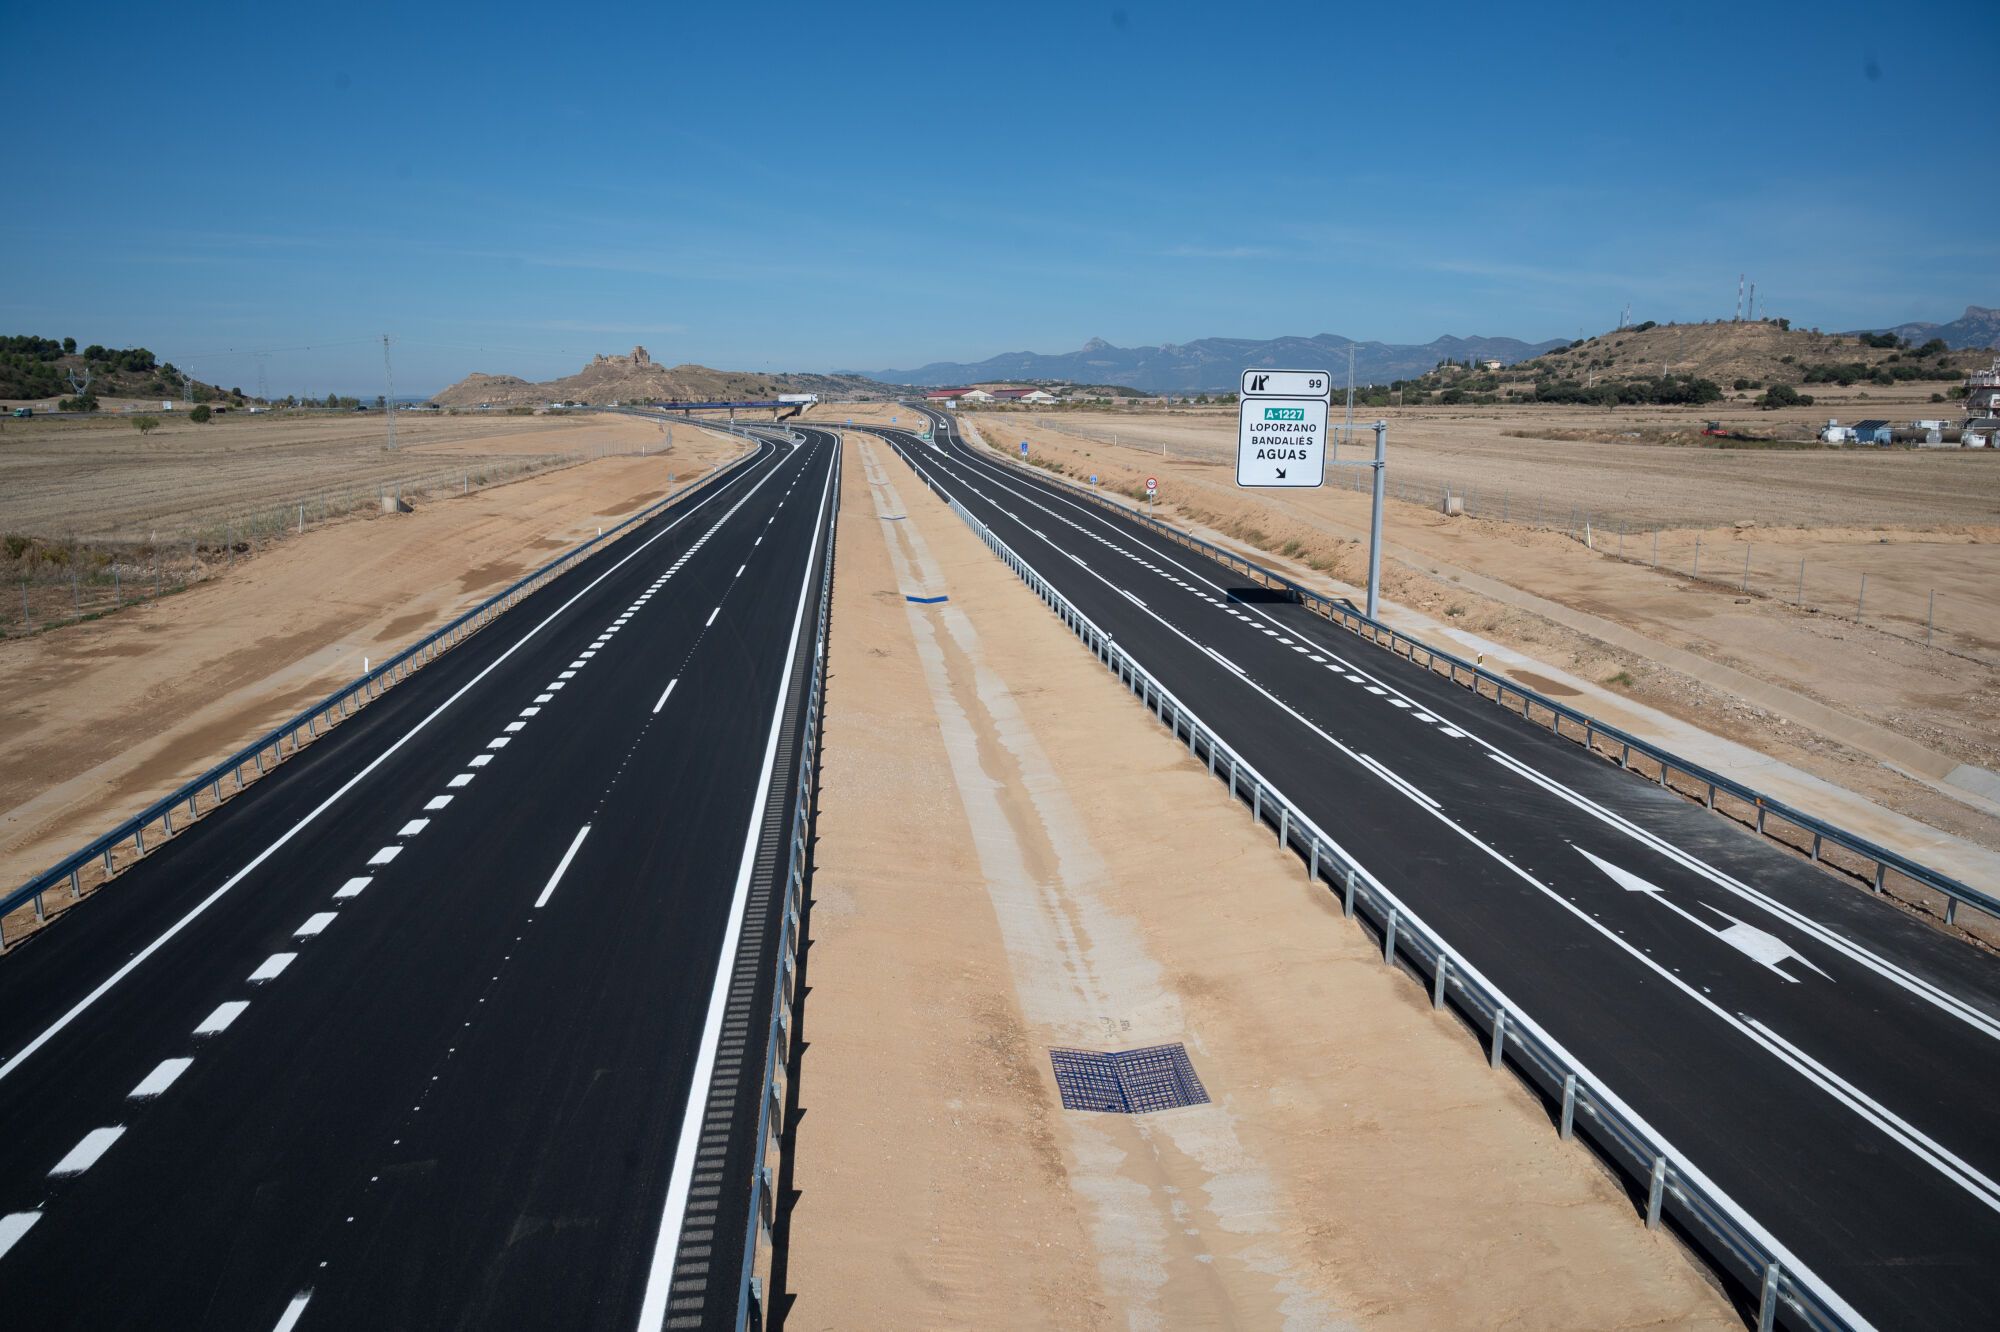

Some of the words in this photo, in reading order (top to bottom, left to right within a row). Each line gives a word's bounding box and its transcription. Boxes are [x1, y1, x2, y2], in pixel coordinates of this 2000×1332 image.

[1308, 379, 1322, 388] 99
[1266, 410, 1303, 420] A-1227
[1250, 424, 1317, 432] LOPORZANO
[1252, 436, 1314, 446] BANDALIÉS
[1256, 449, 1307, 460] AGUAS
